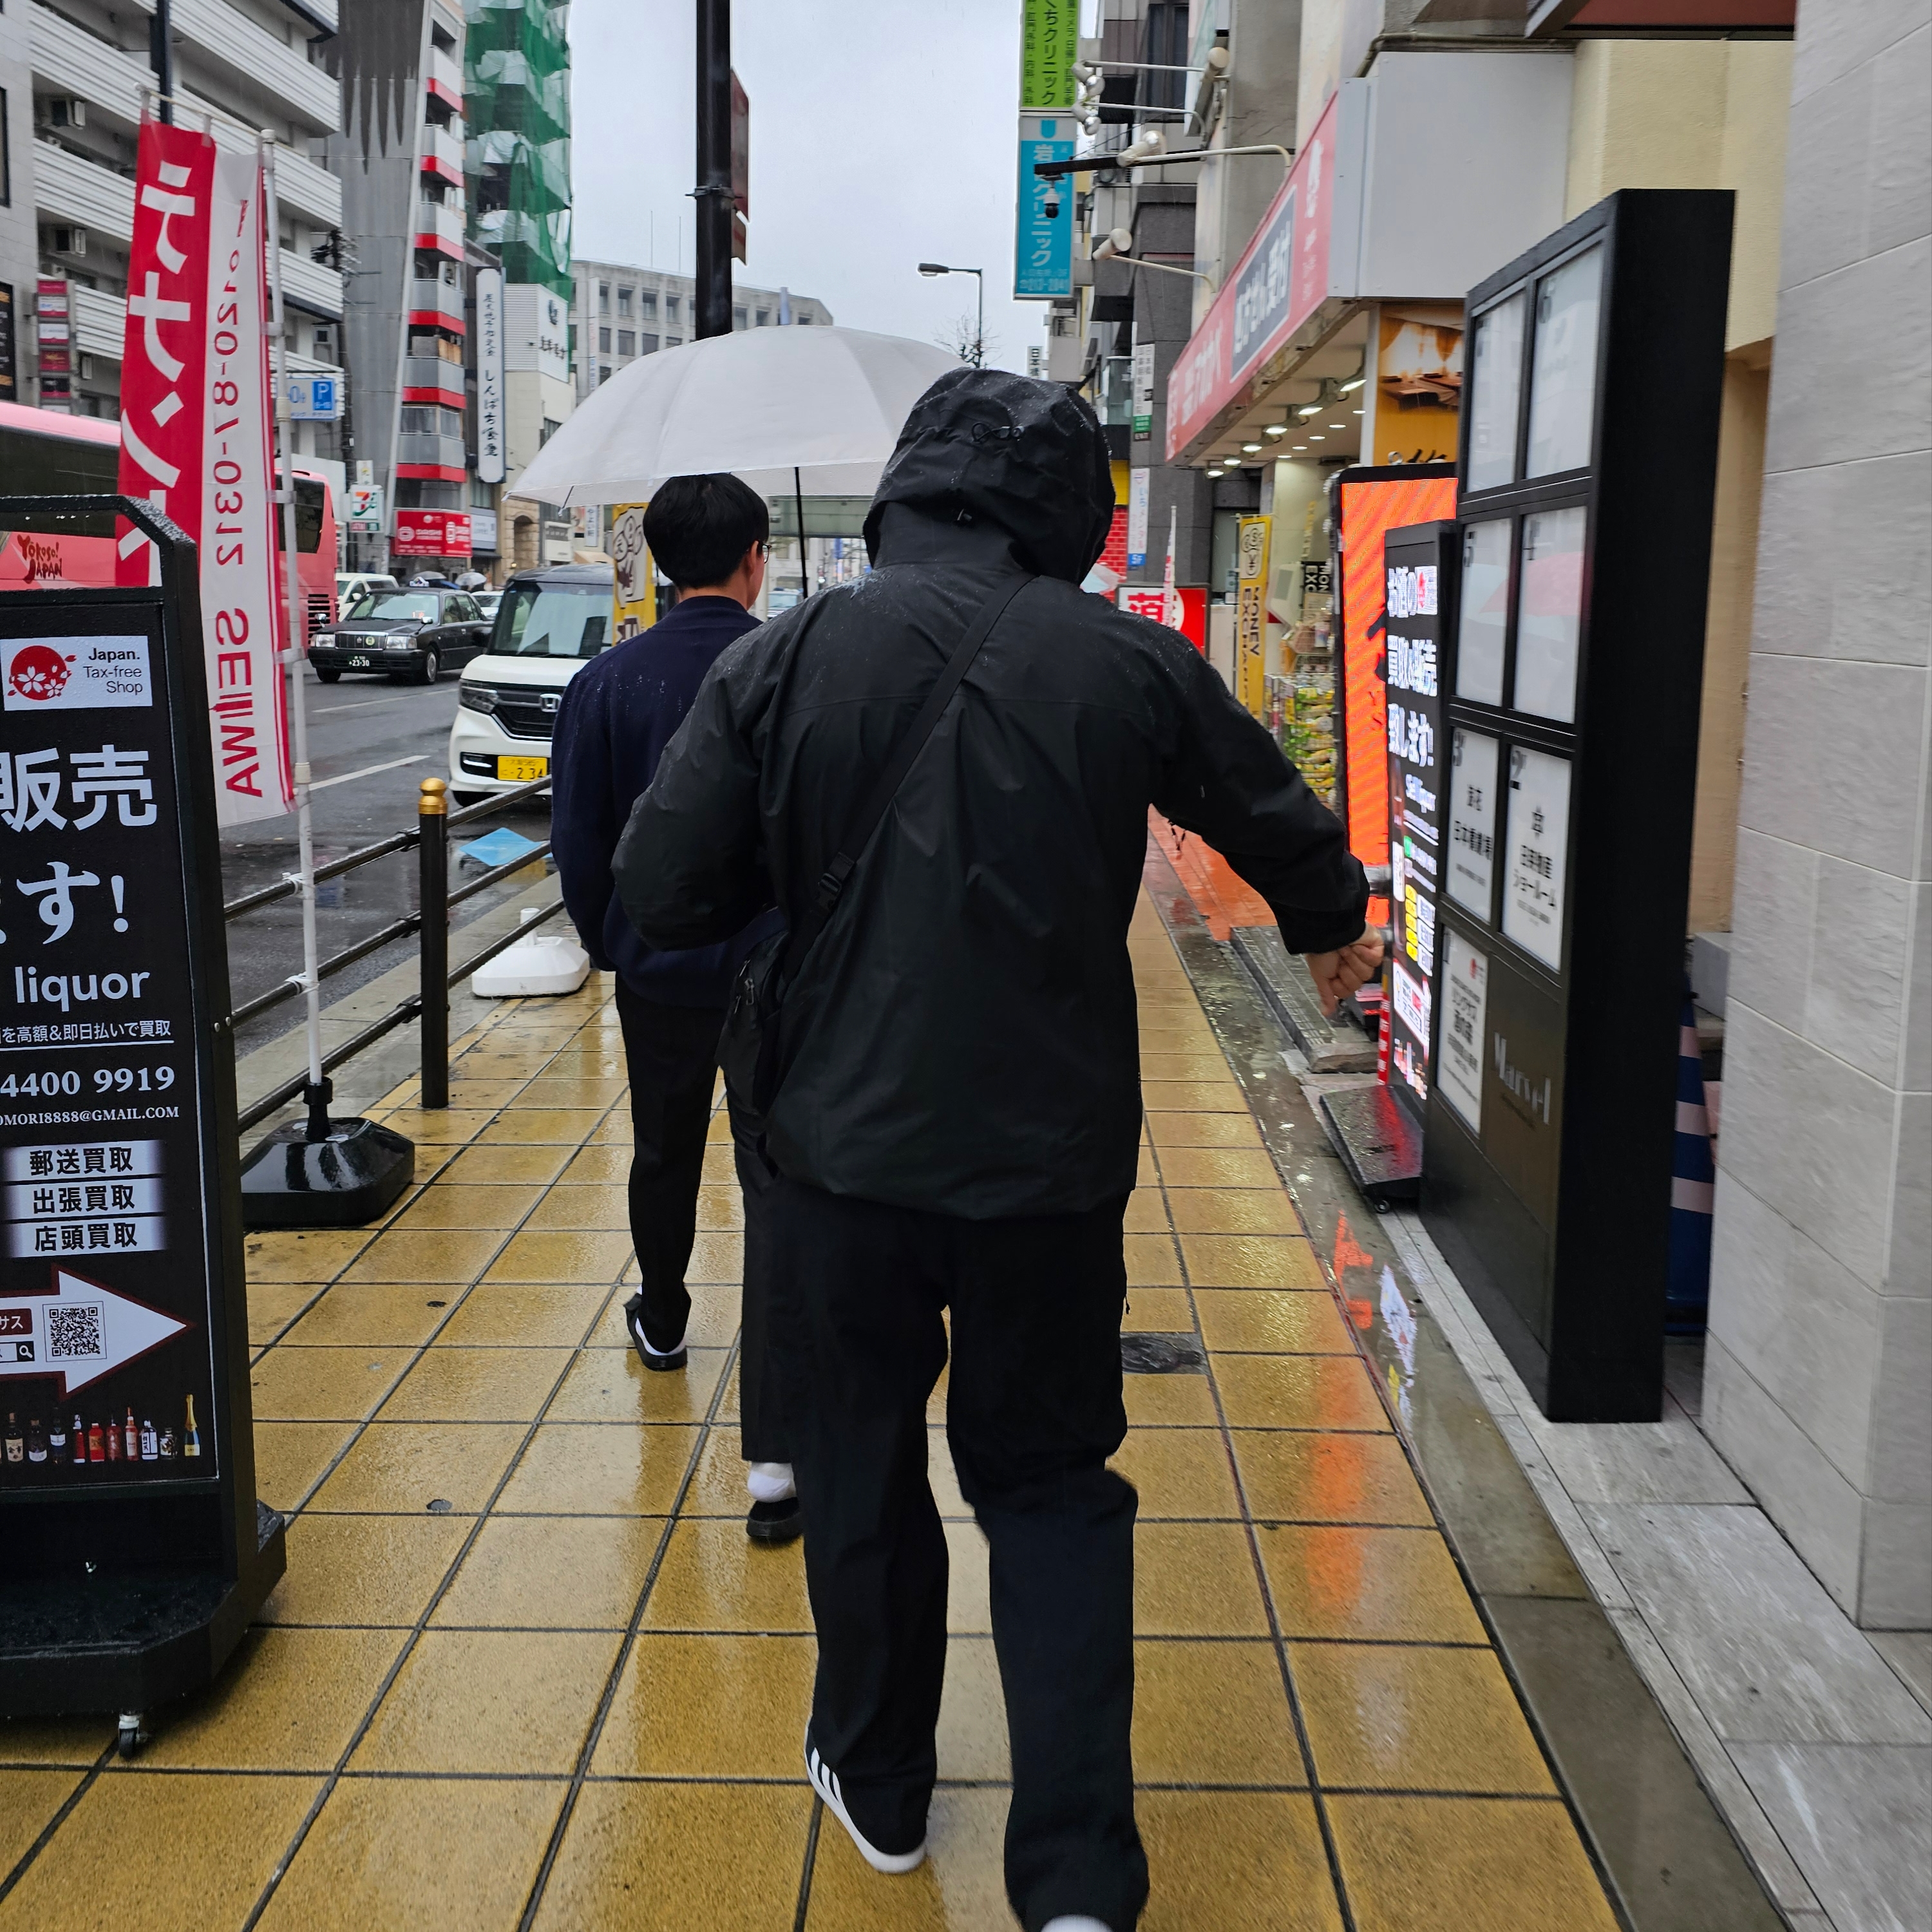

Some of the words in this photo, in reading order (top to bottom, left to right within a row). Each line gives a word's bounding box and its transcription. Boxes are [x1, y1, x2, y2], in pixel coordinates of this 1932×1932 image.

[317, 383, 329, 399] P
[1250, 587, 1260, 656] MONEY
[88, 648, 140, 663] Japan.
[83, 665, 142, 678] Tax-free
[106, 681, 143, 695] Shop
[0, 744, 157, 833] 販売
[15, 967, 151, 1012] liquor
[0, 1071, 80, 1097] 4400
[93, 1066, 175, 1093] 9919
[30, 1147, 133, 1176] 郵送買取
[33, 1185, 135, 1214] 出張買取
[35, 1222, 138, 1252] 店頭買取
